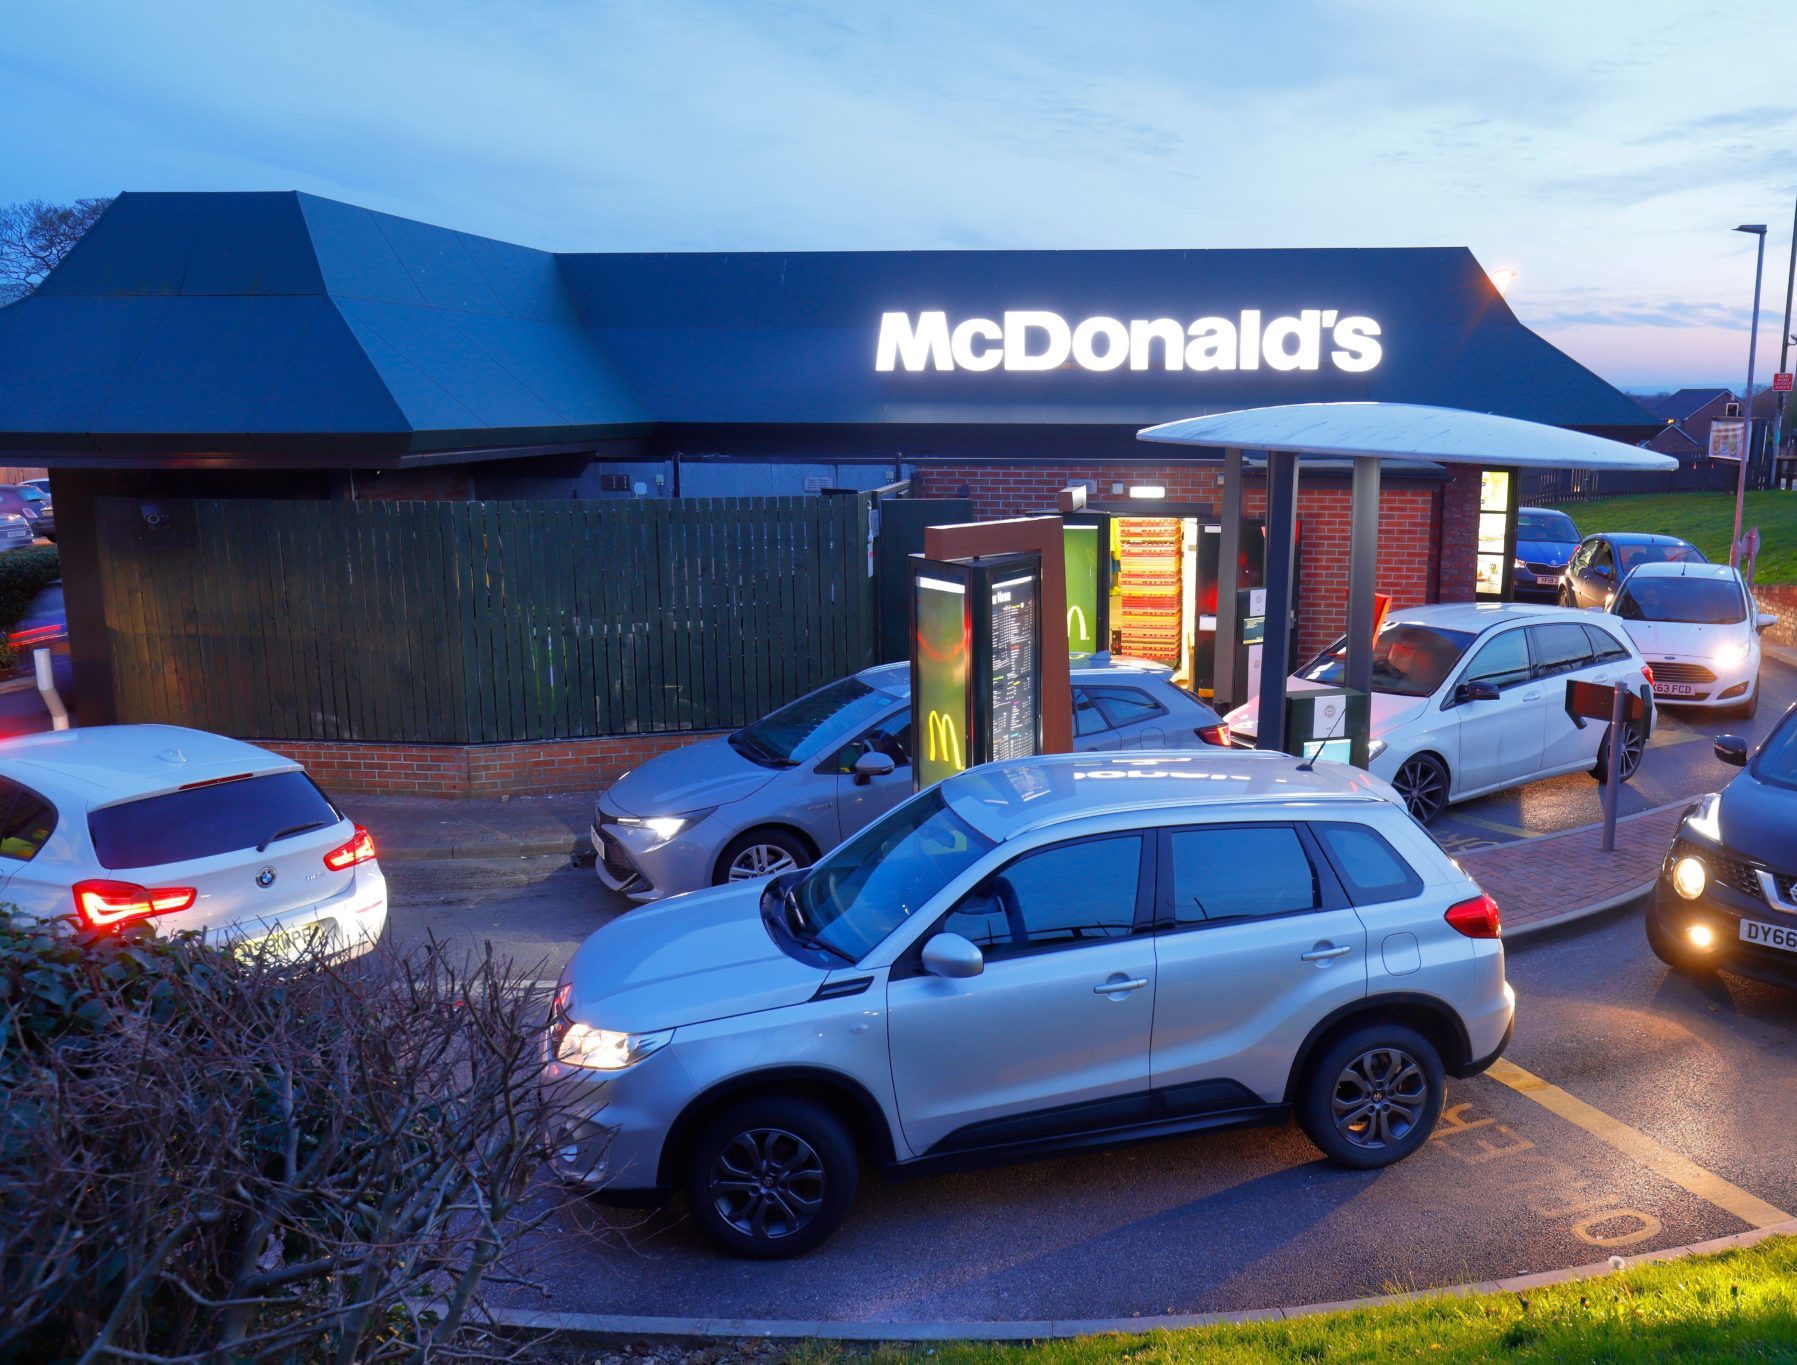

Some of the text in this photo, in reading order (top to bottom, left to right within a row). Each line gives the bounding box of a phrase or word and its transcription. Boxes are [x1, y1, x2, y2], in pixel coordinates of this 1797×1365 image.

[875, 309, 1383, 373] McDonald's
[1672, 684, 1692, 694] FCD
[1747, 922, 1797, 948] DY66
